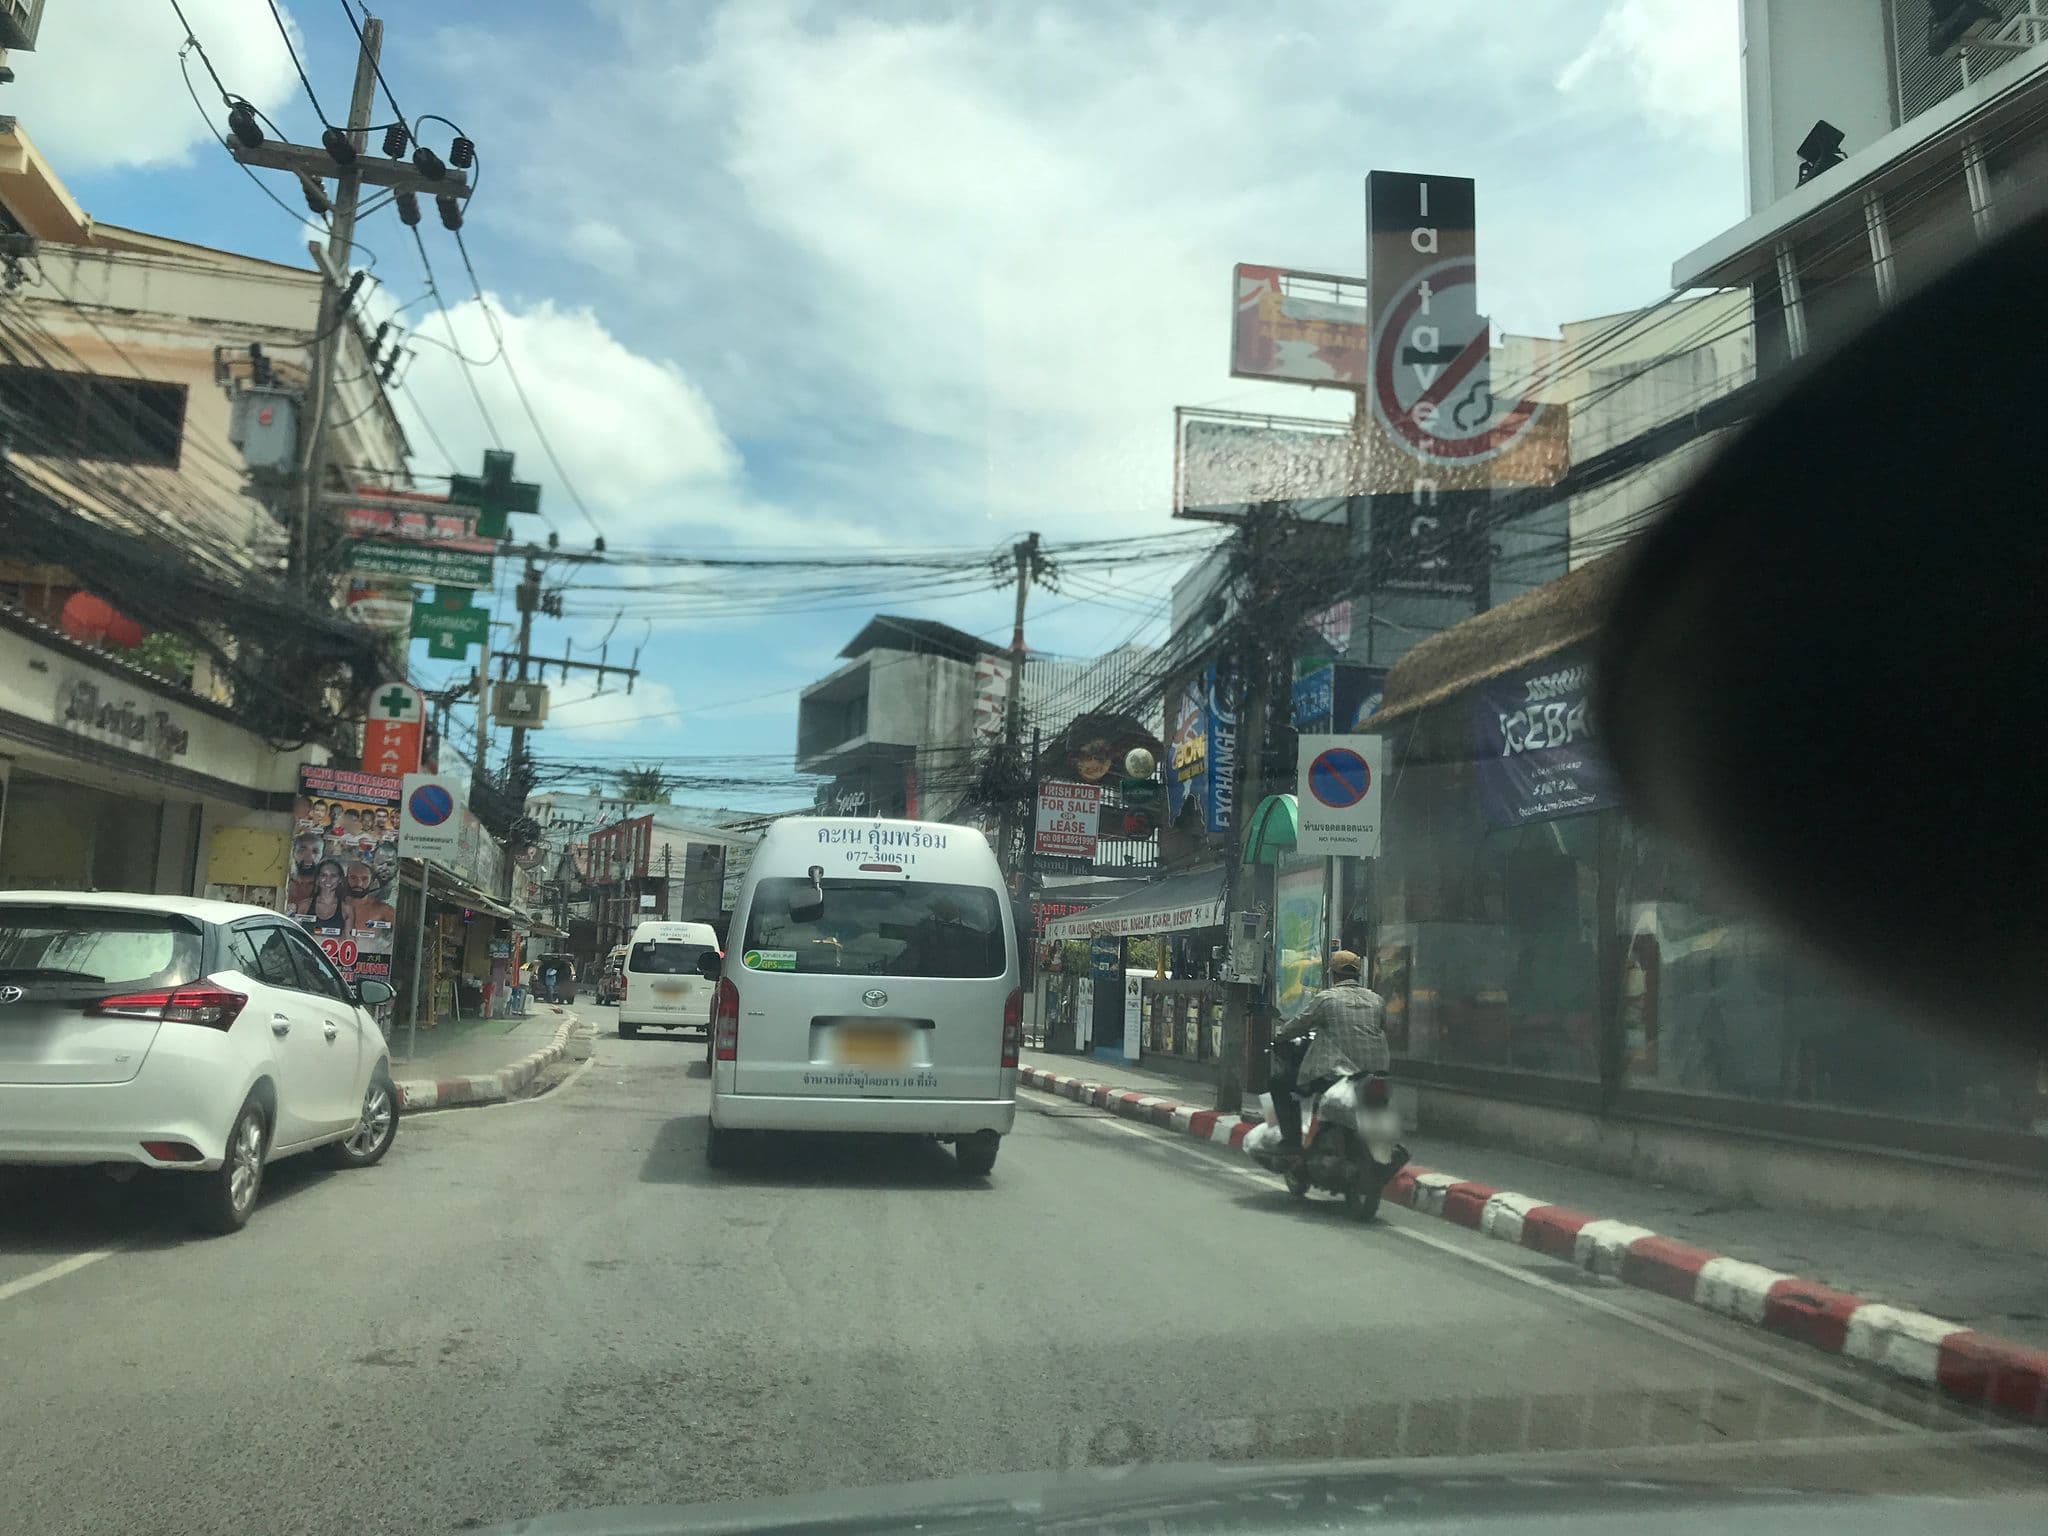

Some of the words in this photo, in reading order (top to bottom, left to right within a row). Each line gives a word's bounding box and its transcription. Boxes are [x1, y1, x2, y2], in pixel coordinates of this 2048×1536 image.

[359, 784, 401, 800] STADIUM
[1045, 785, 1072, 797] IRISH
[1074, 789, 1094, 799] PUB
[1042, 798, 1065, 812] FOR
[1067, 801, 1096, 814] SALE
[1050, 820, 1086, 833] LEASE
[868, 822, 947, 852] คุ้มพร้อม
[846, 851, 916, 864] 077-300511
[321, 938, 358, 966] 20
[353, 962, 389, 976] JUNE
[762, 960, 778, 968] GPS
